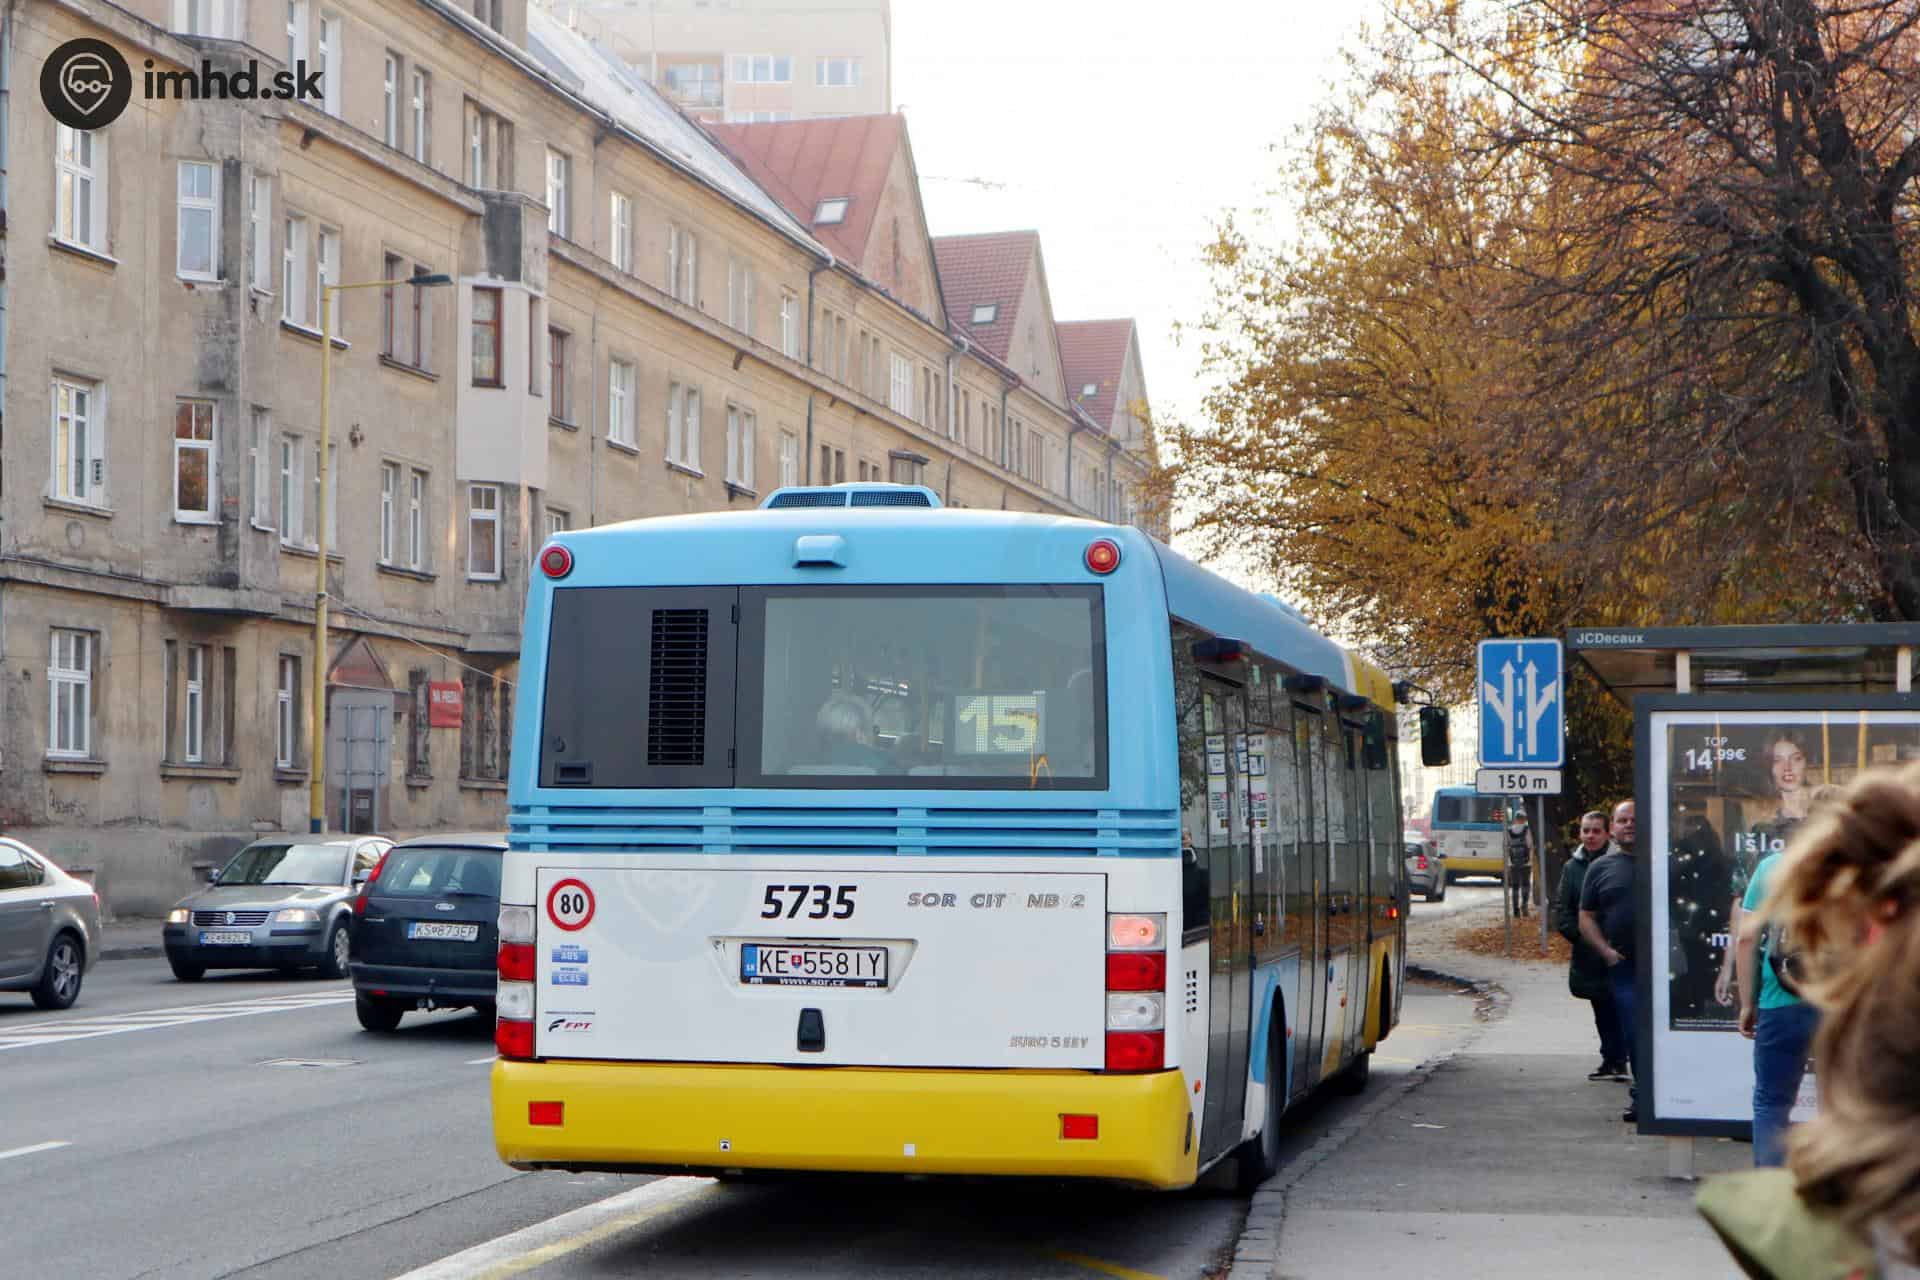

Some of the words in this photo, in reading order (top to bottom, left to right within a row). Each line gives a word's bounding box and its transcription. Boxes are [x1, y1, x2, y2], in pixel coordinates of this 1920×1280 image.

[1576, 632, 1645, 645] JCDecaux
[959, 696, 1037, 752] 15
[1703, 737, 1729, 746] TOP
[1498, 774, 1527, 789] 150
[1533, 778, 1547, 789] m
[560, 894, 584, 914] 80
[761, 885, 857, 919] 5735
[907, 892, 957, 908] SOR
[1027, 894, 1060, 909] NB
[759, 950, 789, 974] KE
[803, 951, 881, 977] 558IY
[779, 977, 846, 986] www.sor.cz
[564, 1021, 593, 1030] FPT
[1050, 1036, 1061, 1048] 5
